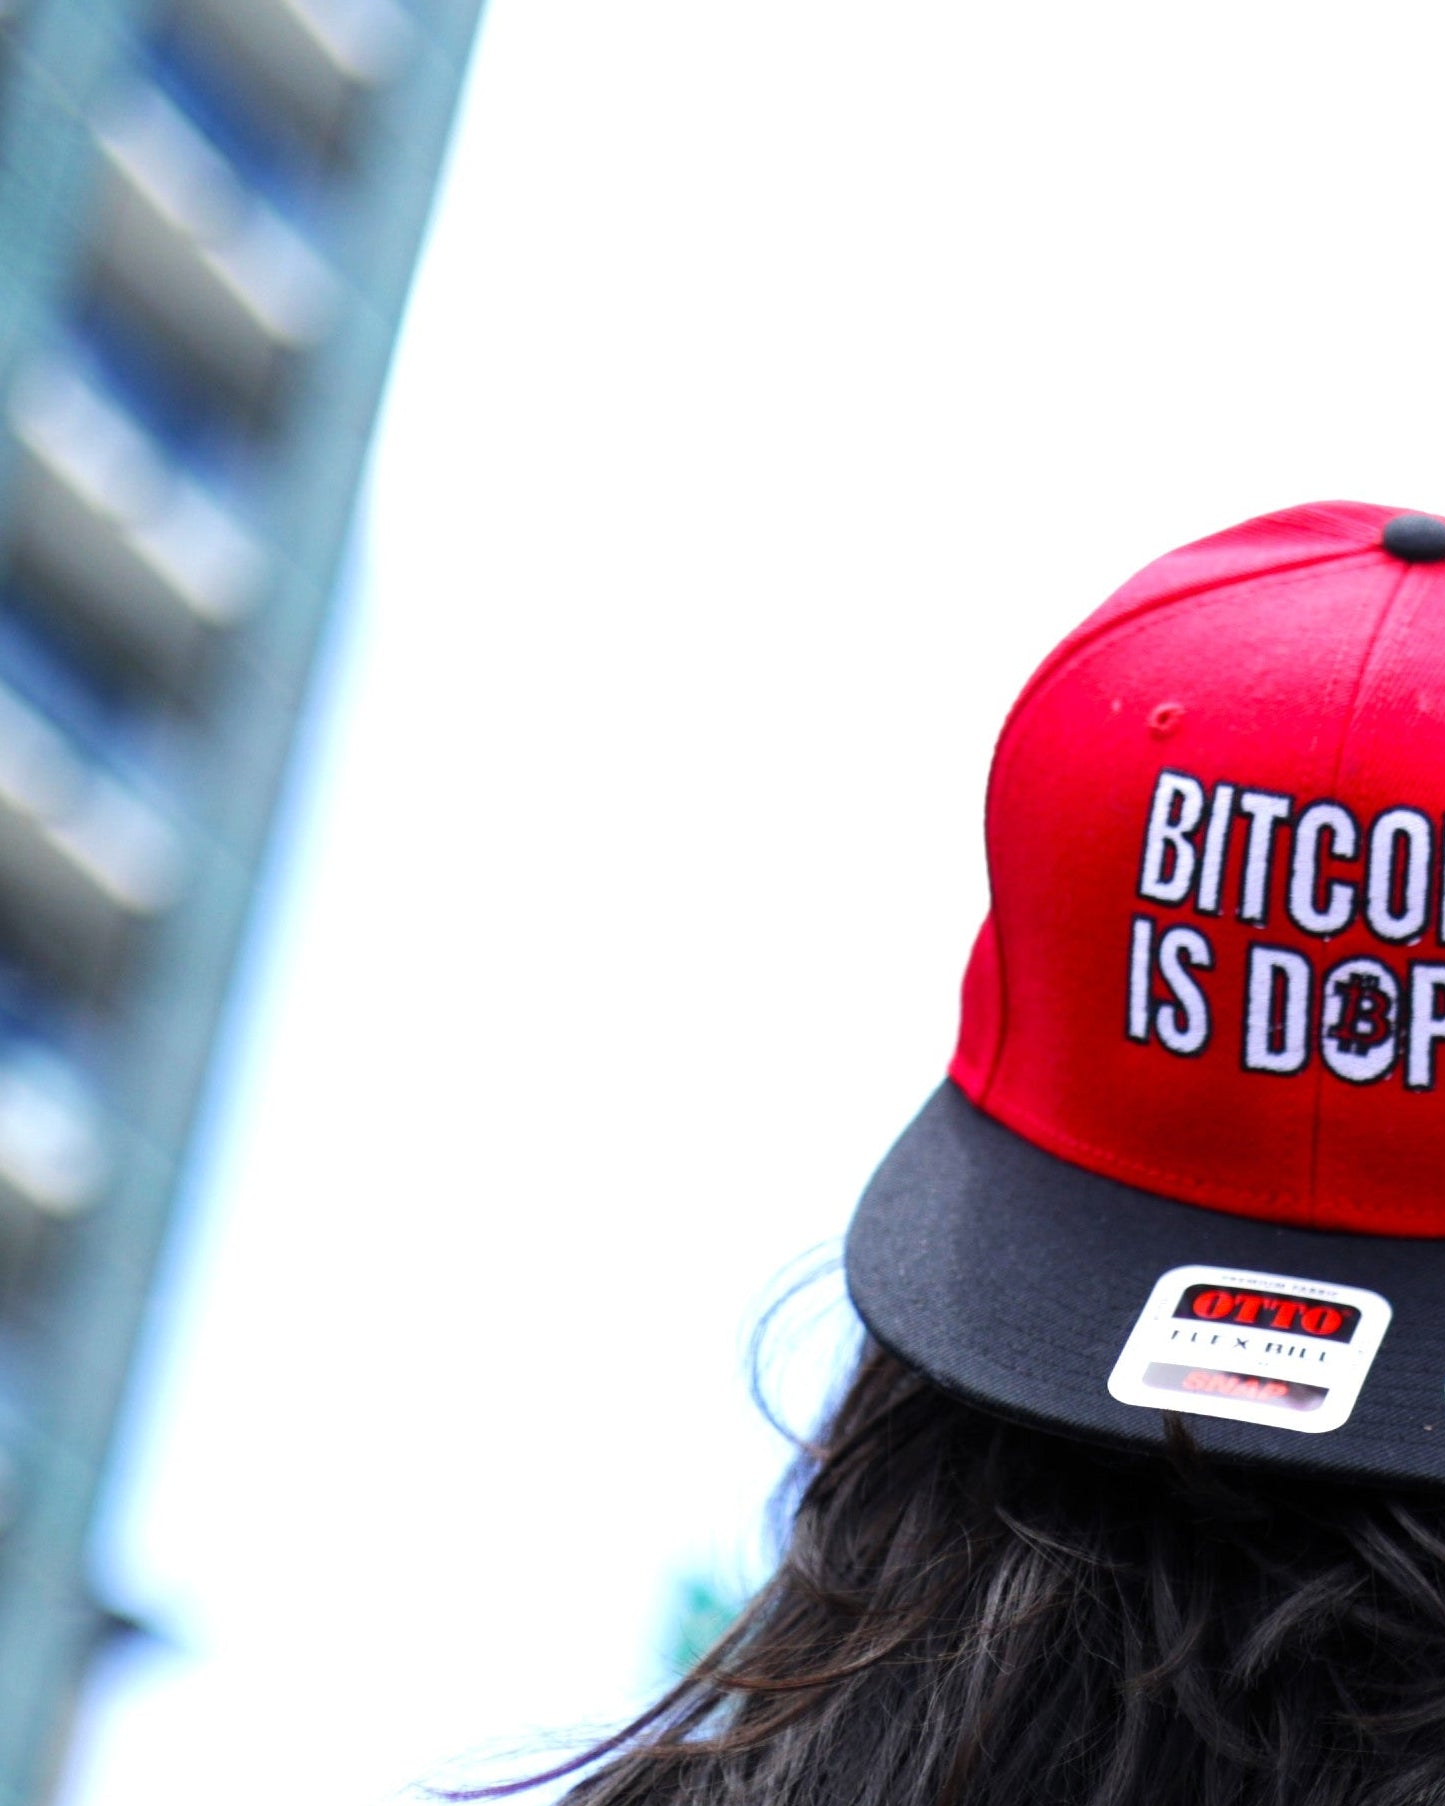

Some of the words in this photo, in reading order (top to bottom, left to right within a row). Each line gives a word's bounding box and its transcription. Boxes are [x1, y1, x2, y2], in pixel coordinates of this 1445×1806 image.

[1127, 915, 1213, 1057] IS
[1192, 1289, 1343, 1336] OTTO
[1170, 1329, 1250, 1350] FLEX
